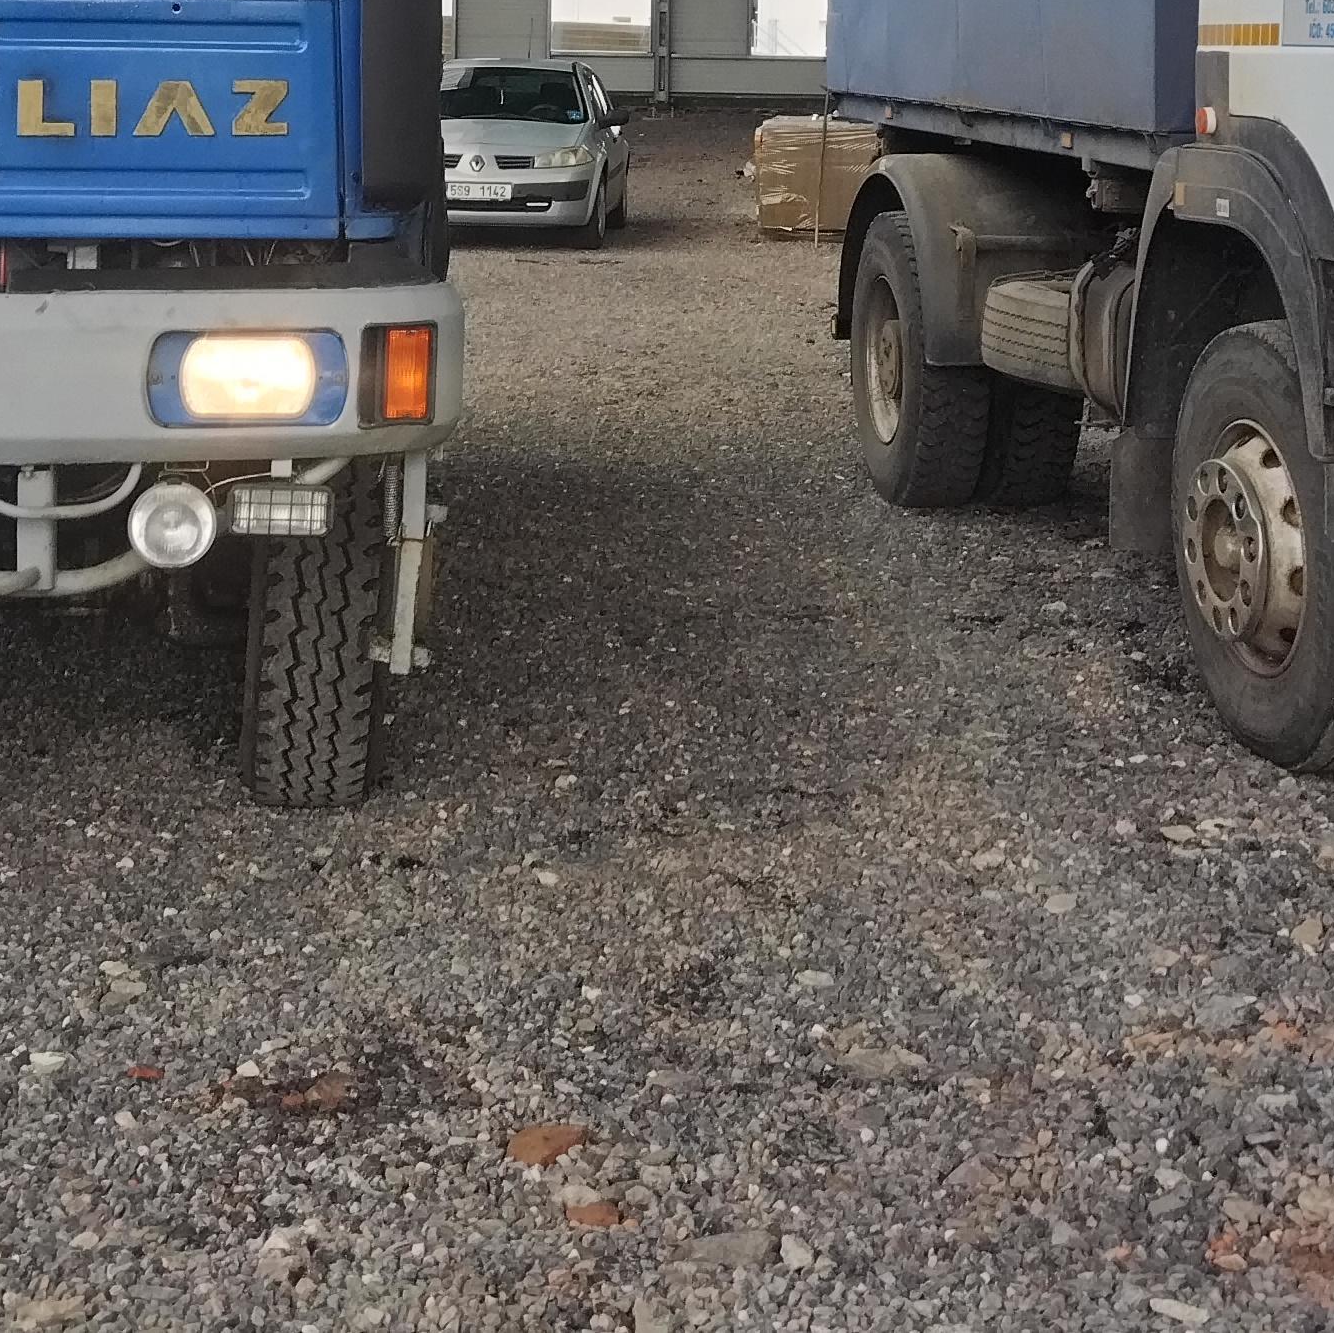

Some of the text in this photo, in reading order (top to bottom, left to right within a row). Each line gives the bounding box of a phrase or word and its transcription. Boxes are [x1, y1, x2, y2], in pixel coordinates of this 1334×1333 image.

[16, 79, 289, 137] LIAZ
[450, 184, 507, 198] 5S9 1142
